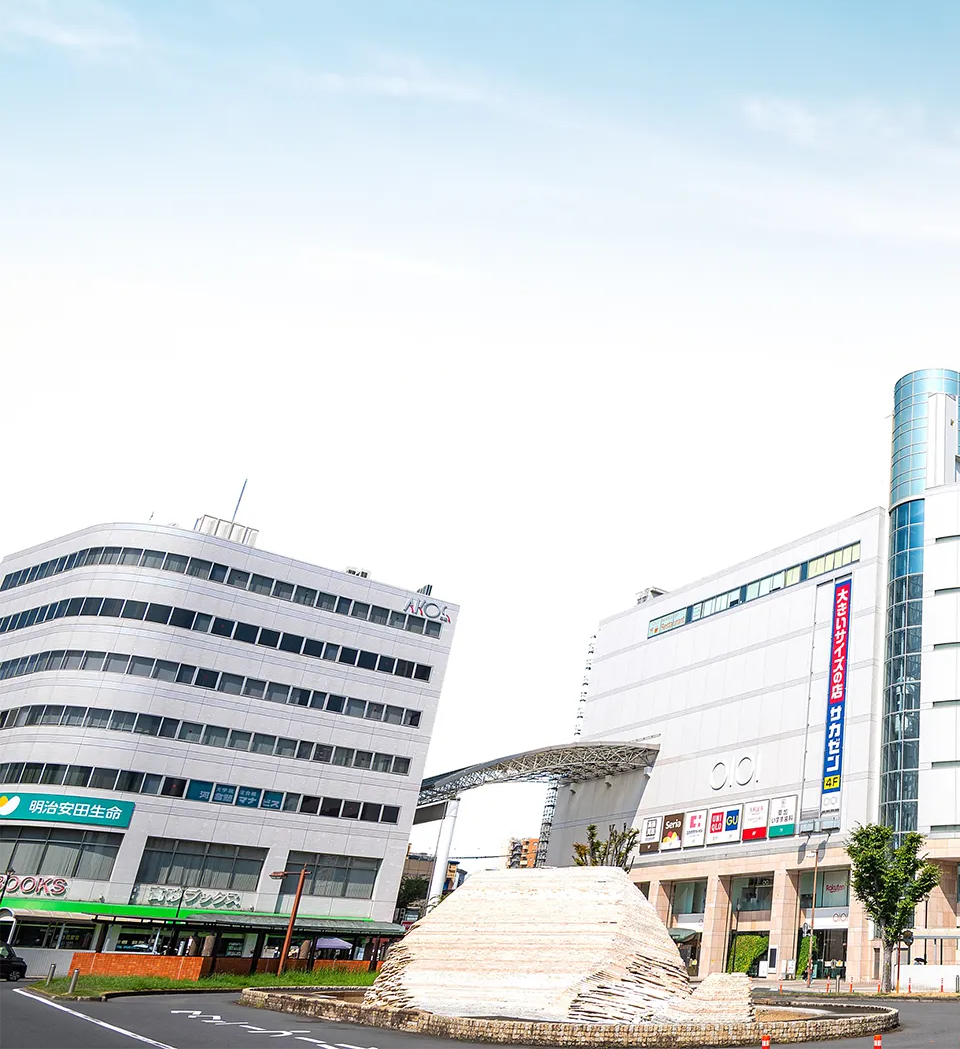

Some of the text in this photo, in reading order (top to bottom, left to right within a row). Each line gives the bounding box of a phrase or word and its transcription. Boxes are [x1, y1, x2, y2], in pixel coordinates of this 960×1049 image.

[403, 597, 451, 624] AKOS
[831, 588, 849, 699] 大きいサイズの店
[826, 705, 843, 772] サカゼン
[825, 776, 839, 787] 4F
[29, 800, 123, 820] 明治安田生命
[726, 815, 739, 827] GU
